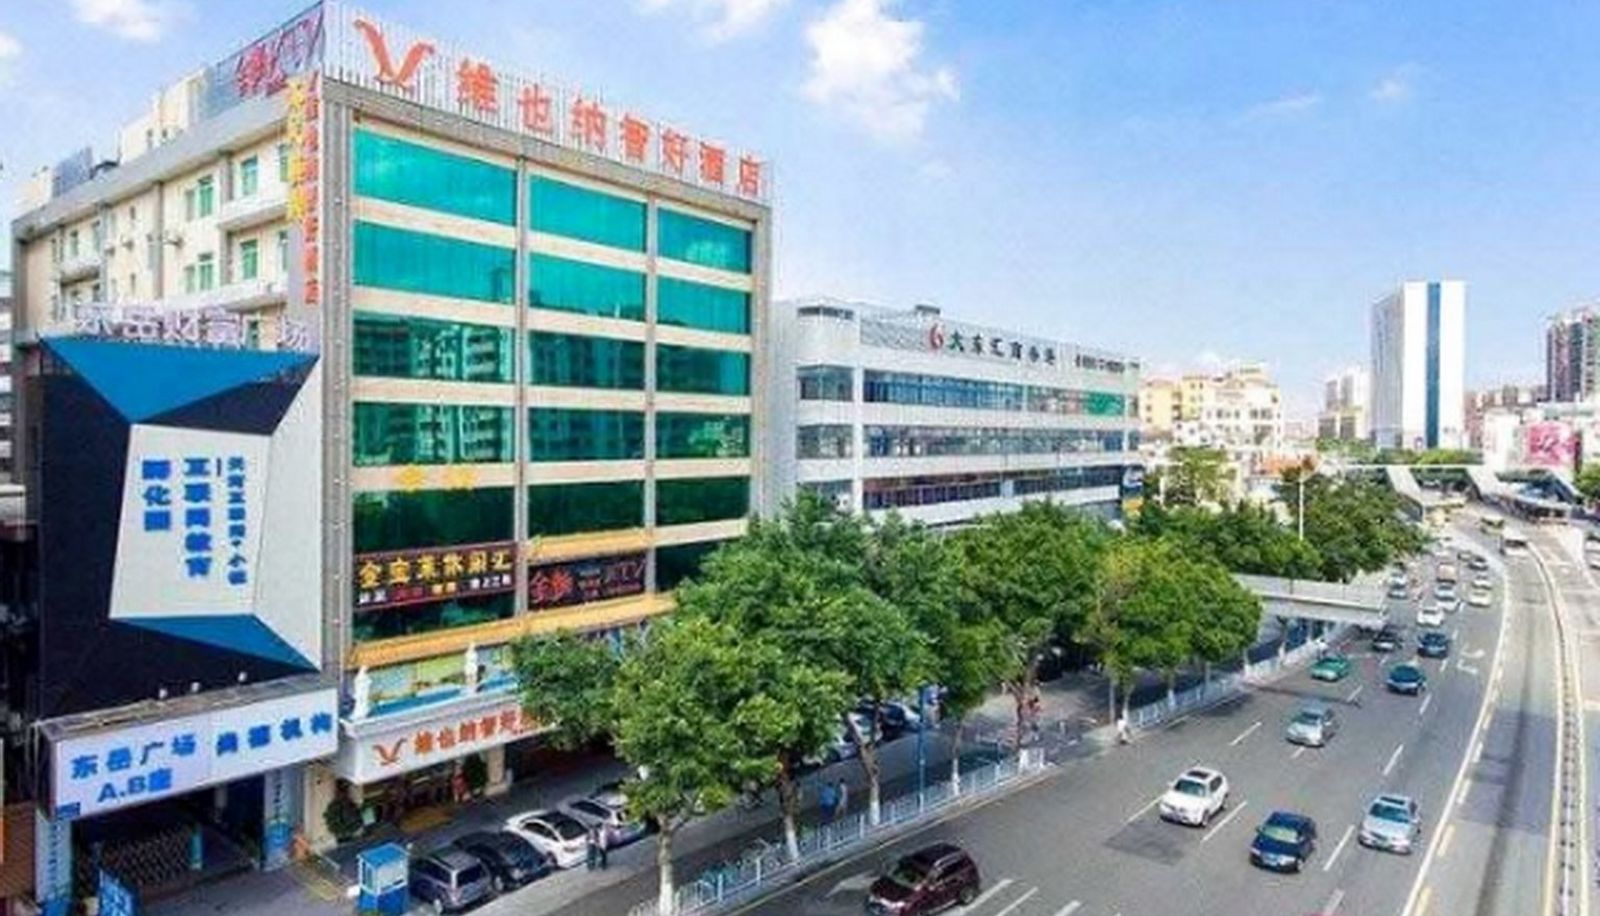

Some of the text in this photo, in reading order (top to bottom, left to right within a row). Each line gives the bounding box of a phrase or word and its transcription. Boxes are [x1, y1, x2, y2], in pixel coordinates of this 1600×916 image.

[456, 56, 763, 196] 维也纳智好酒店
[70, 732, 196, 780] 东岳广场
